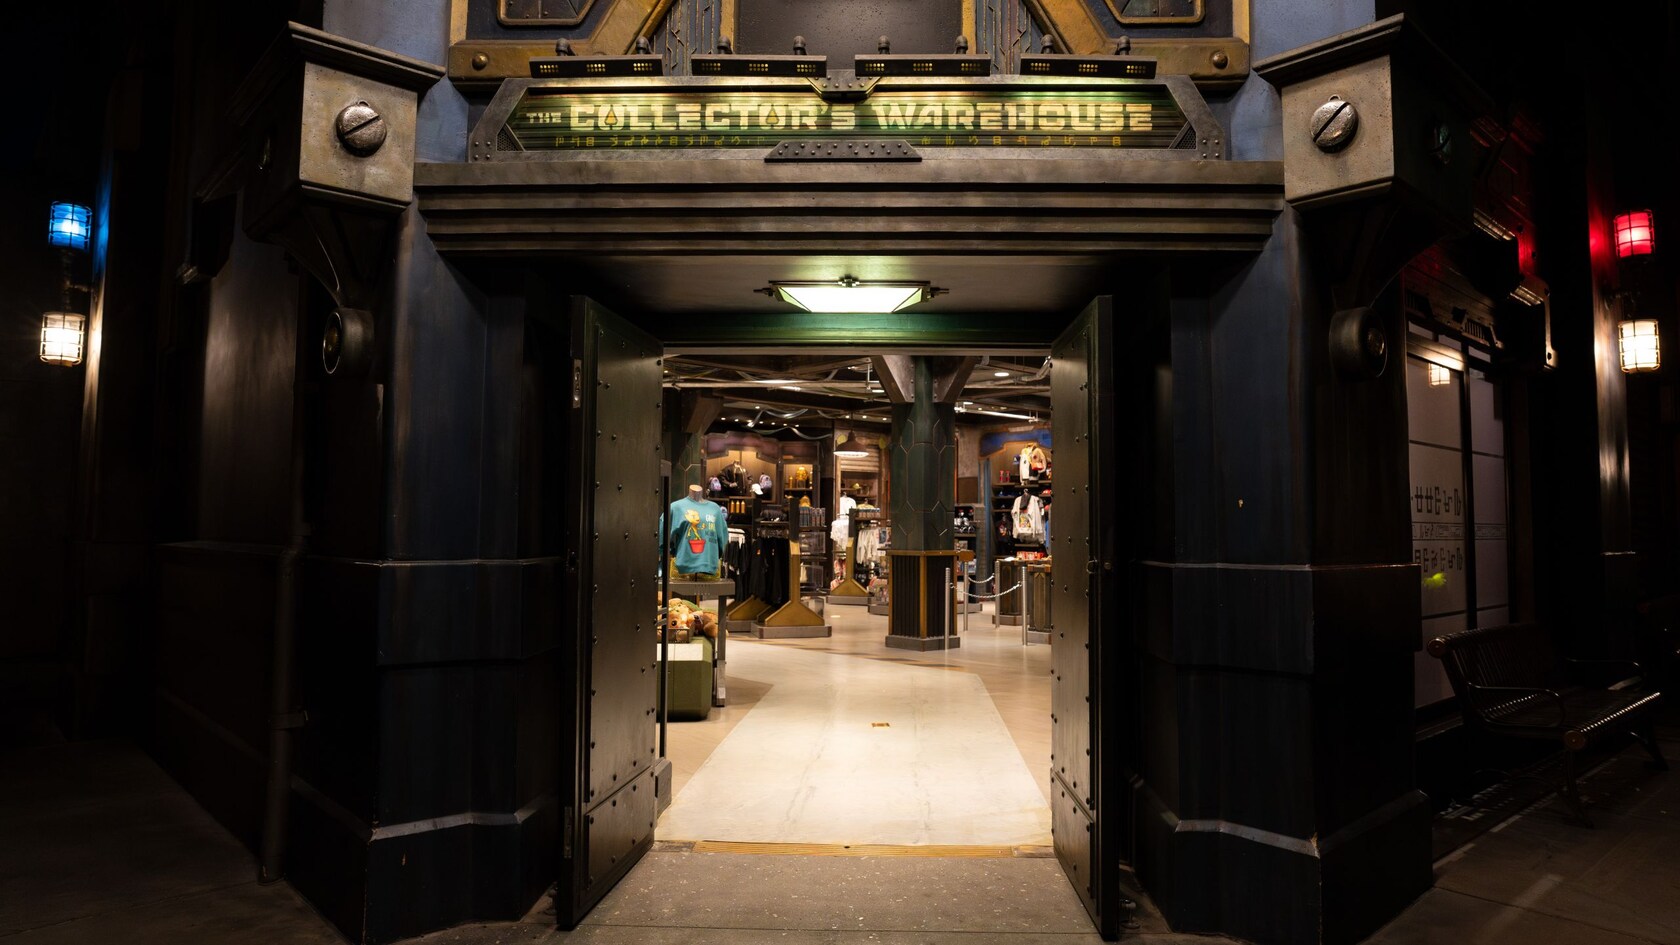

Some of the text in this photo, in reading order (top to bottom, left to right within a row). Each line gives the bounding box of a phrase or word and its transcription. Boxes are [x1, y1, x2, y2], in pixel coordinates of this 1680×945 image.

[526, 102, 1153, 131] THE COLLECTOR'S WAREHOUSE
